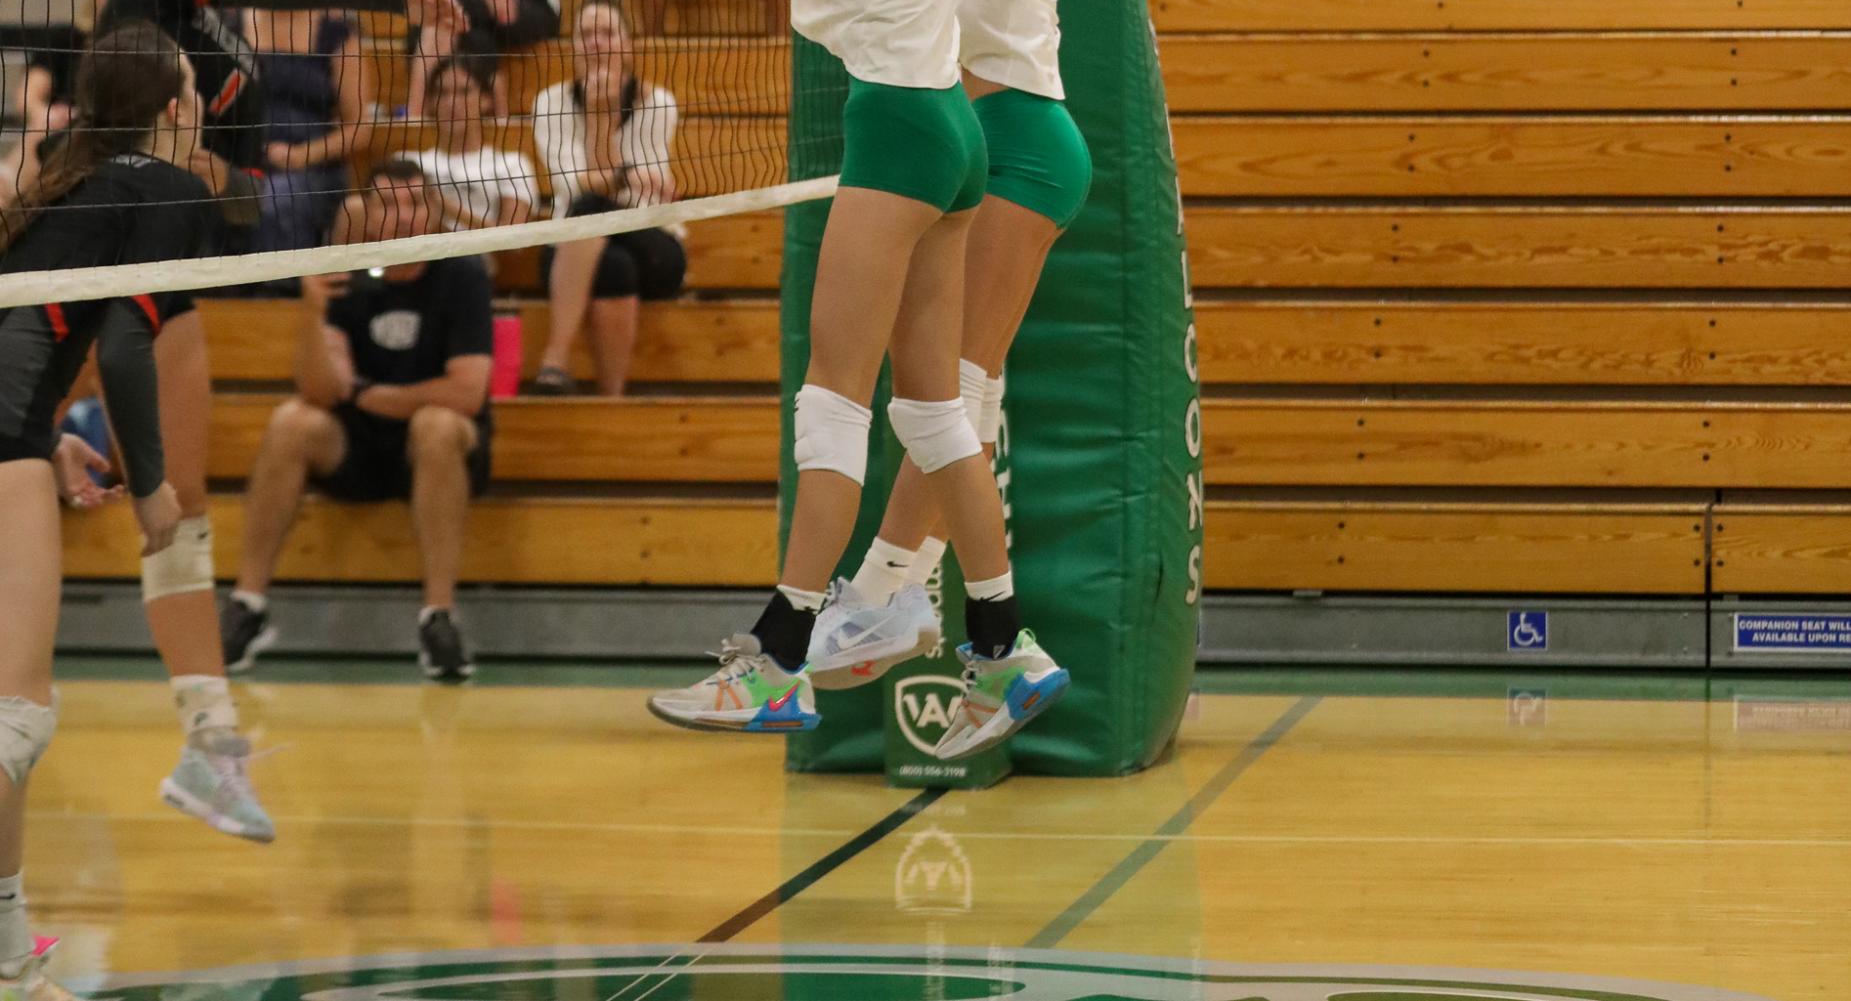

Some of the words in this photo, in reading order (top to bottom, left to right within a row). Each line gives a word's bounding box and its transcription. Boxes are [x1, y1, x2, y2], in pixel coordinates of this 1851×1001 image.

[1739, 620, 1799, 630] COMPANION
[1801, 620, 1826, 630] SEAT
[1828, 620, 1851, 630] WILL
[1752, 633, 1806, 643] AVAILABLE
[1808, 633, 1837, 643] UPON
